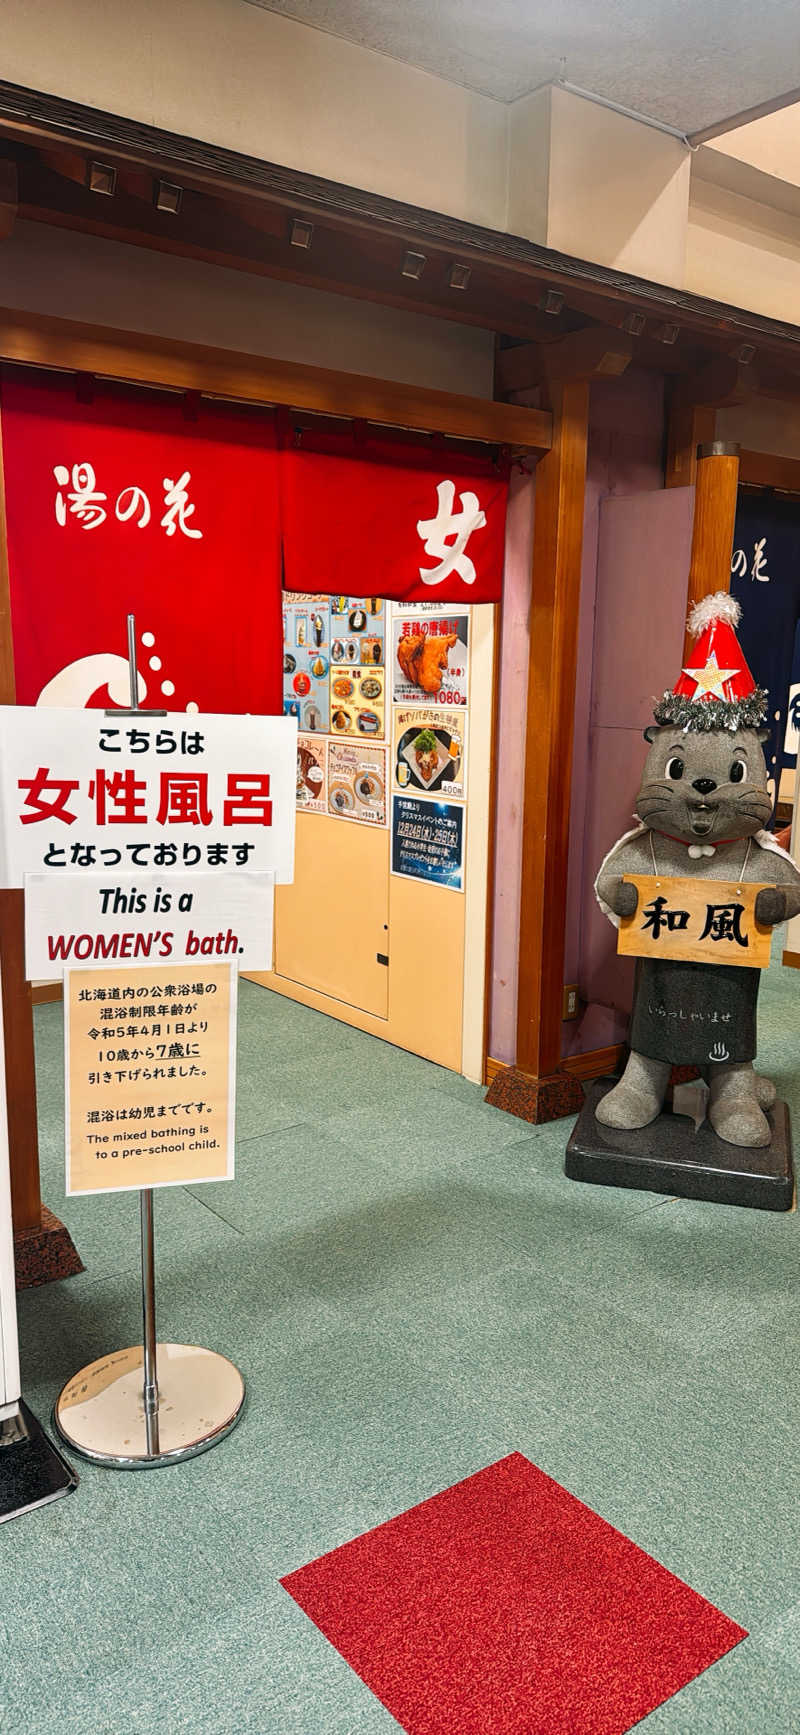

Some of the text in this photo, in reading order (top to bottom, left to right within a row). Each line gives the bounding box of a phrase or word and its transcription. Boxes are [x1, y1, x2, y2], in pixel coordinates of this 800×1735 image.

[54, 462, 203, 539] 湯の花
[416, 479, 487, 585] 女
[98, 728, 205, 756] こちらは
[17, 767, 274, 828] 女性風呂
[43, 842, 255, 867] となっております
[98, 887, 194, 914] This is a
[641, 896, 749, 948] 和風
[47, 928, 244, 961] WOMEN'S bath.
[78, 983, 218, 1002] 北海道内の公衆浴場の
[99, 1003, 198, 1020] 混浴制限年齢が
[648, 1003, 732, 1023] いらっしゃいませ
[87, 1021, 209, 1040] 令和5年4月1日より
[98, 1042, 200, 1062] 10歳から7歳に
[87, 1065, 208, 1084] 引き下げられました。
[87, 1102, 213, 1123] 混浴は幼児までです。
[86, 1124, 209, 1144] The mixed bathing is
[95, 1138, 220, 1159] to a pre-school child.
